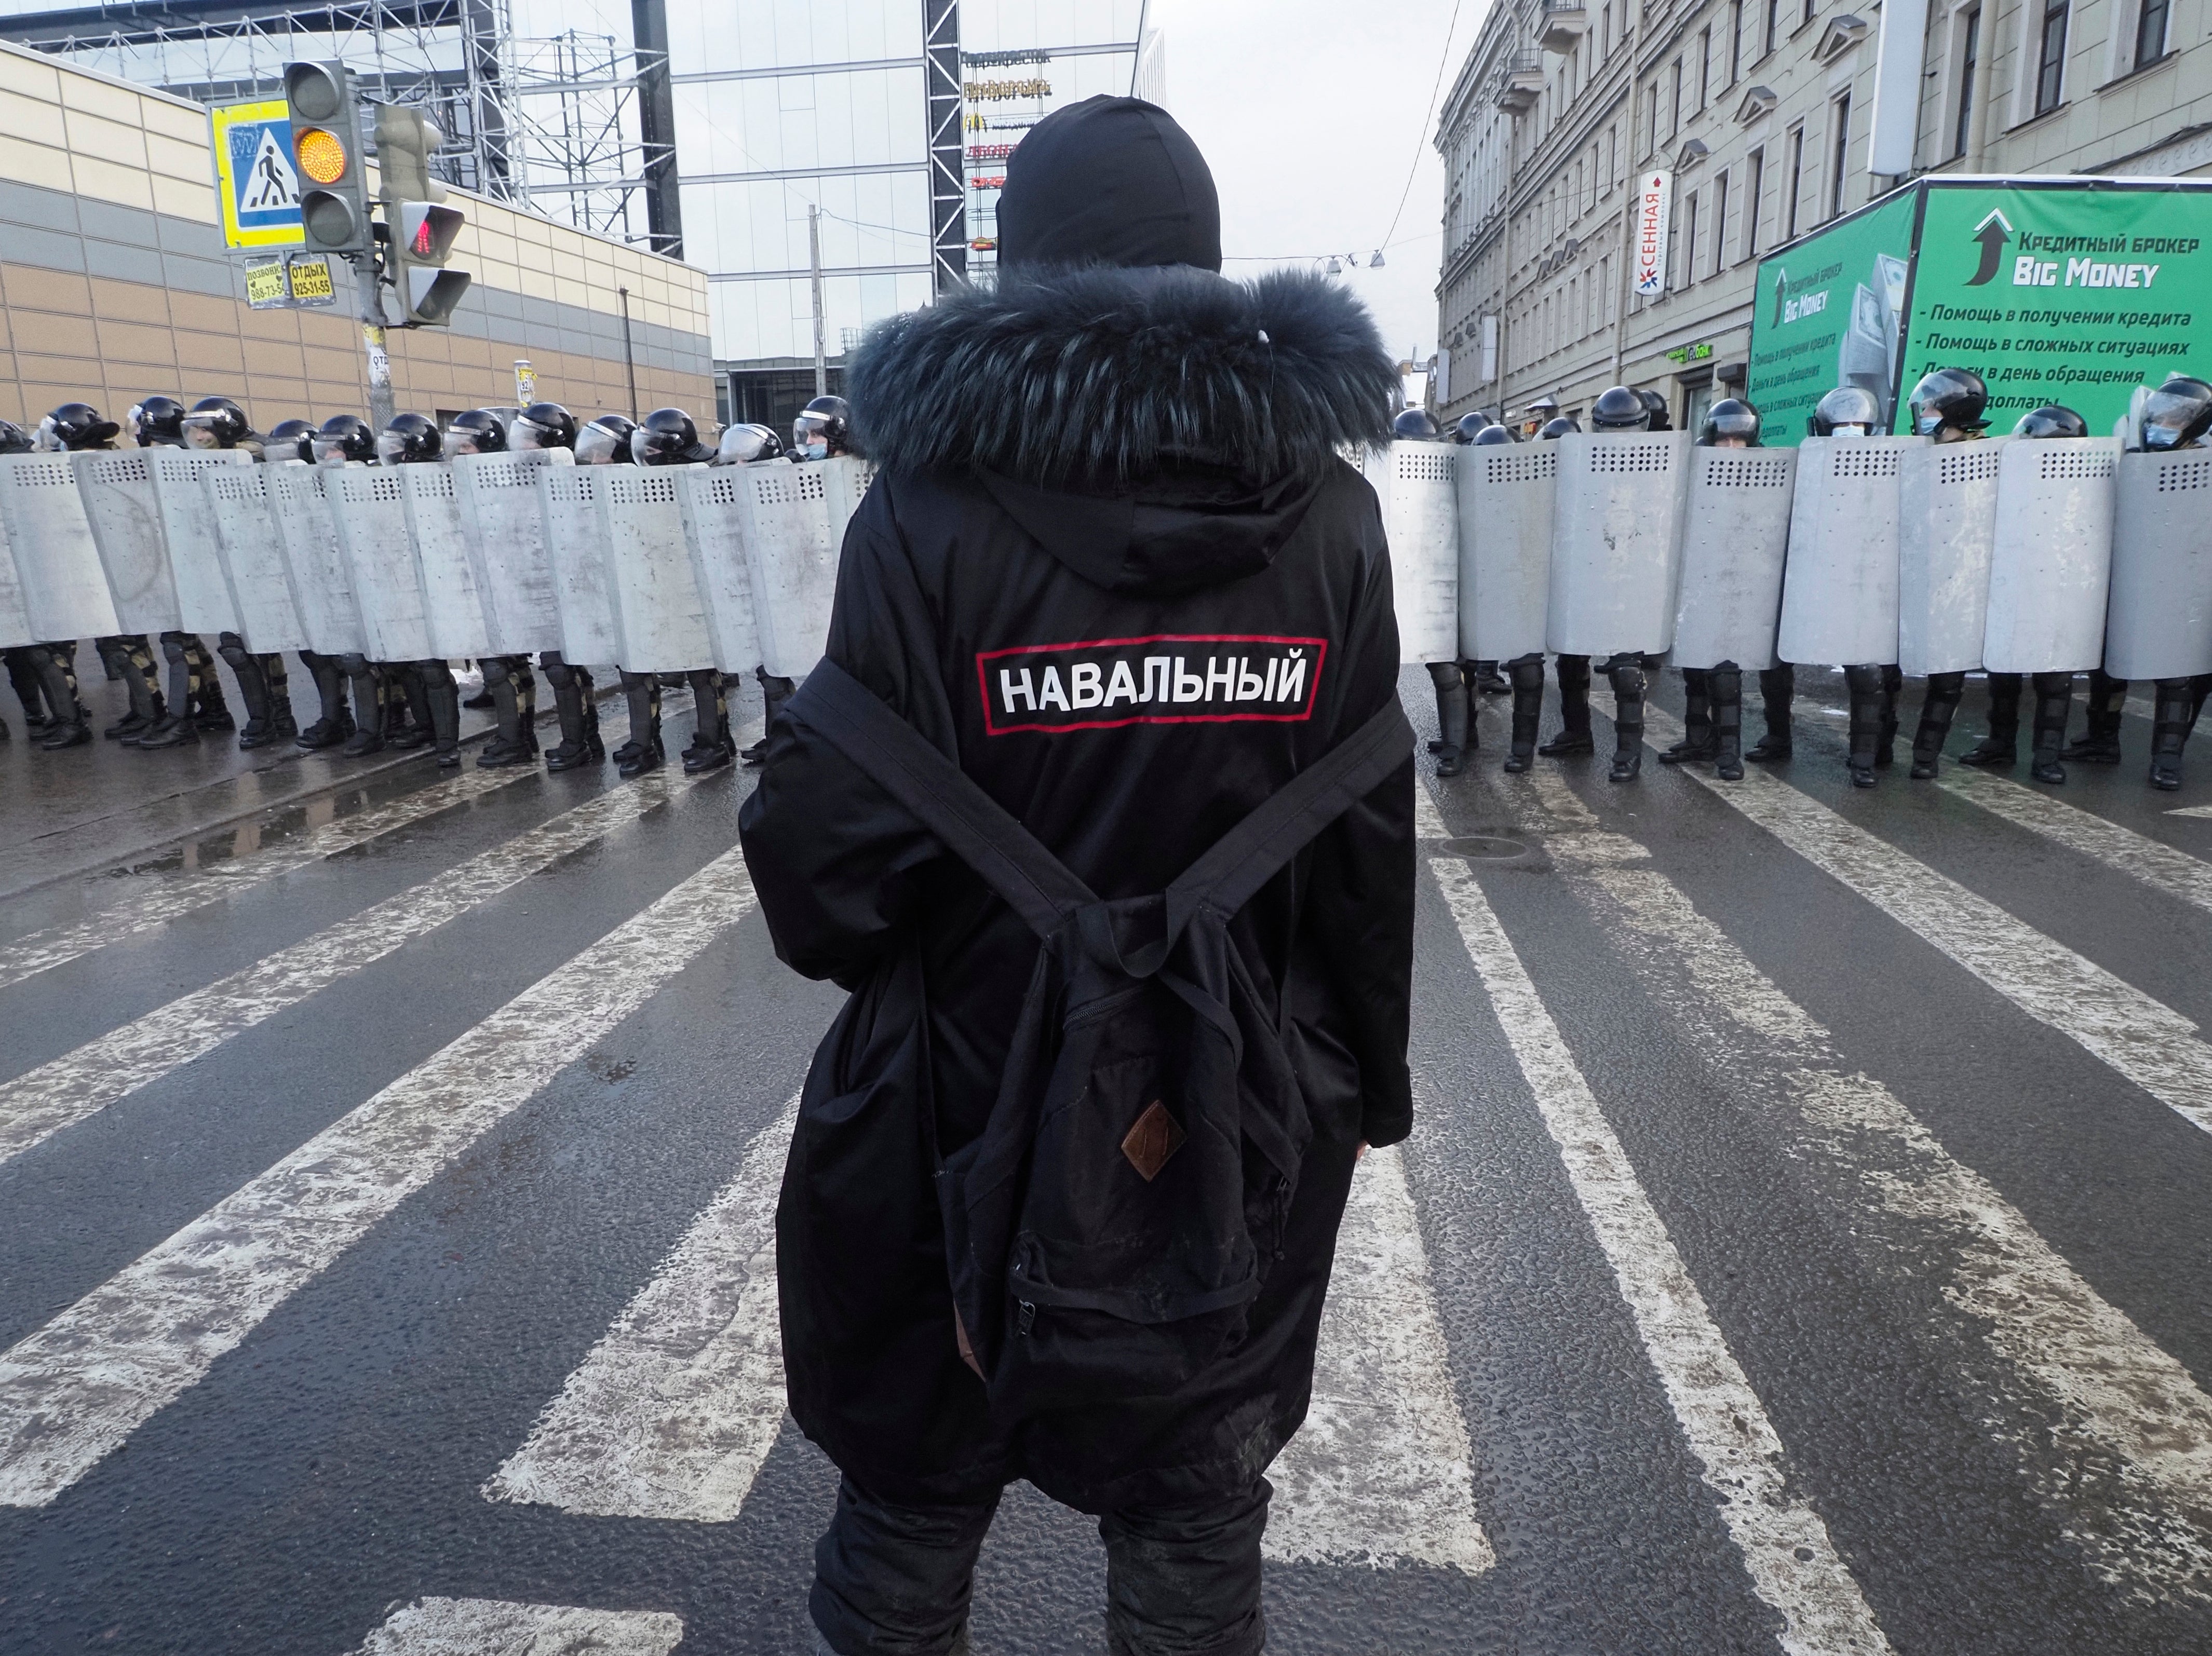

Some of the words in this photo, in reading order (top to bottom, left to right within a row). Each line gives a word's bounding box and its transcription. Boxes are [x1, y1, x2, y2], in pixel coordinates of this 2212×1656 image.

[1641, 194, 1659, 266] СЕННАЯ
[247, 265, 281, 280] ПОЗВОНИ!
[292, 264, 326, 280] ОТДЫХ
[294, 280, 330, 295] 925-31-55
[1930, 304, 2002, 323] Помощь
[2006, 310, 2015, 321] в
[2019, 310, 2114, 327] получении
[2117, 312, 2192, 329] кредита
[1926, 333, 1998, 352] Помощь
[2001, 340, 2010, 350] в
[2015, 339, 2094, 353] сложных
[2097, 342, 2190, 358] ситуациях
[1987, 368, 1998, 379] в
[1999, 367, 2041, 382] день
[2046, 364, 2144, 385] обращения
[1000, 648, 1306, 713] НАВАЛЬНЫЙ
